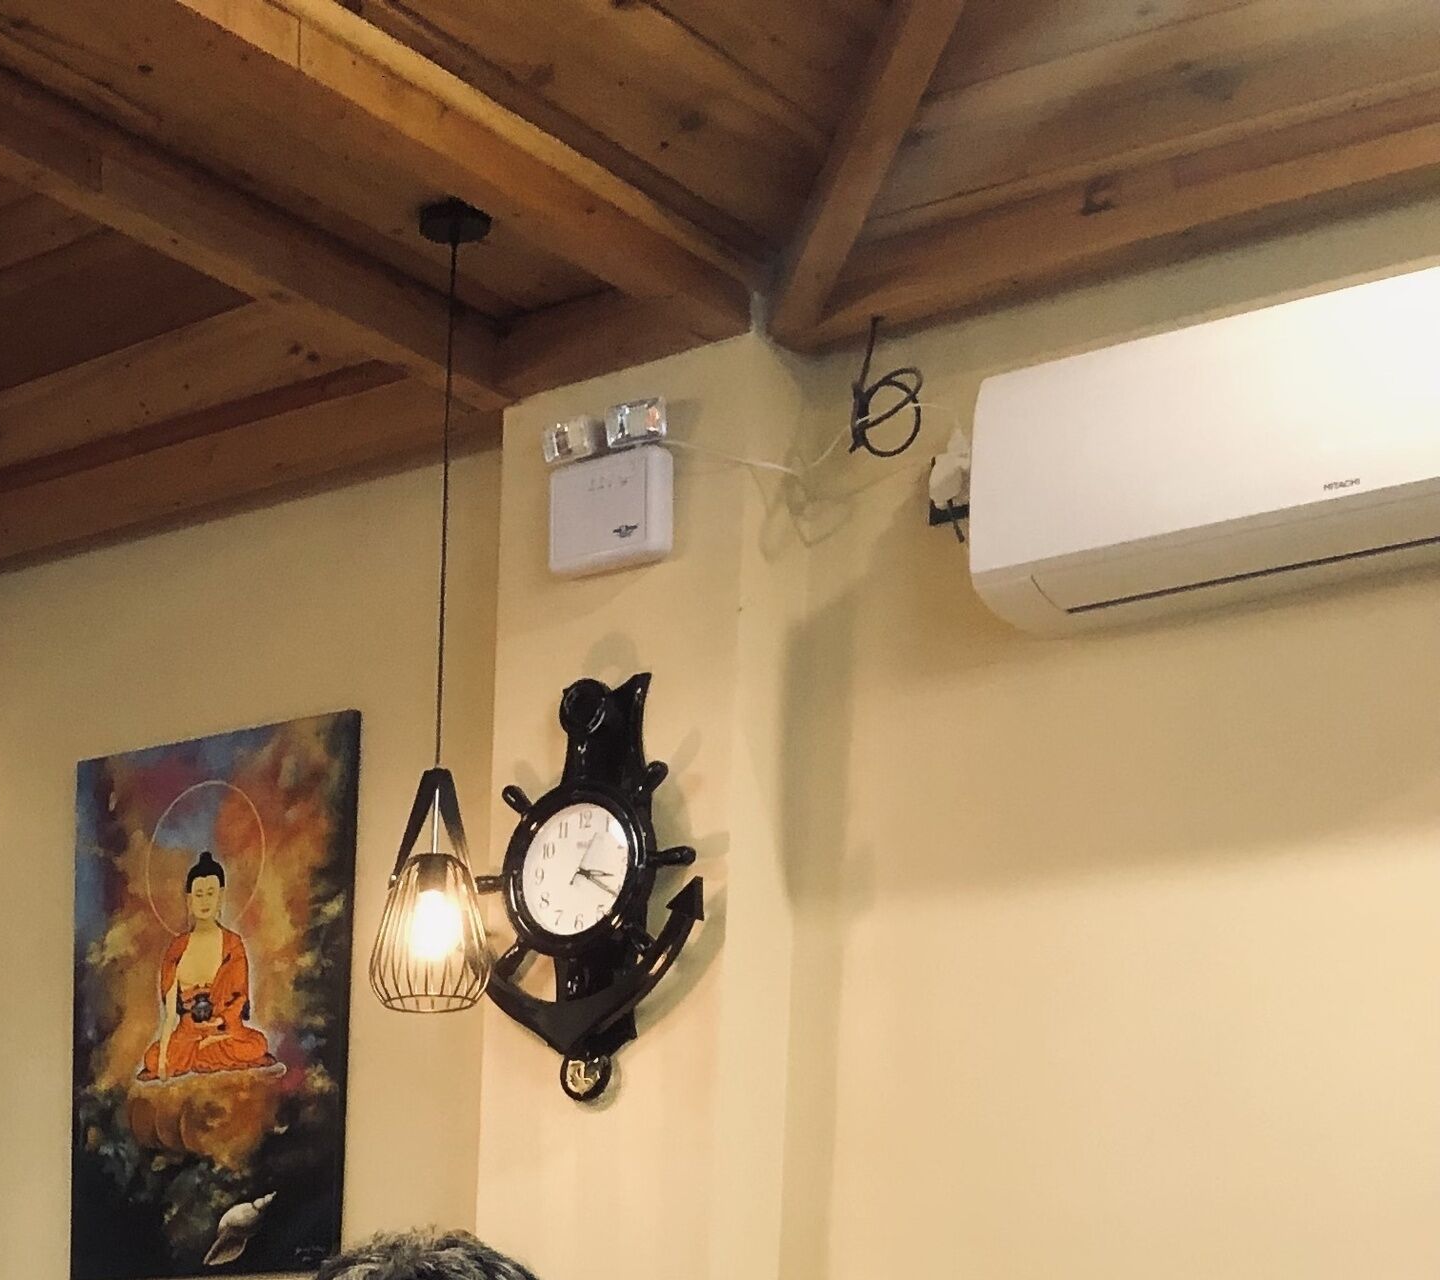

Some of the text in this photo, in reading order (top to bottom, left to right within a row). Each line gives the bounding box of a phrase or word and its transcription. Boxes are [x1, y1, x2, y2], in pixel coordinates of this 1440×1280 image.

[1322, 477, 1361, 491] HITACHI
[578, 810, 593, 830] 12
[558, 821, 569, 840] 11
[542, 842, 556, 860] 10
[535, 867, 545, 886] 9
[539, 891, 551, 909] 8
[554, 908, 564, 927] 7
[573, 913, 584, 931] 6
